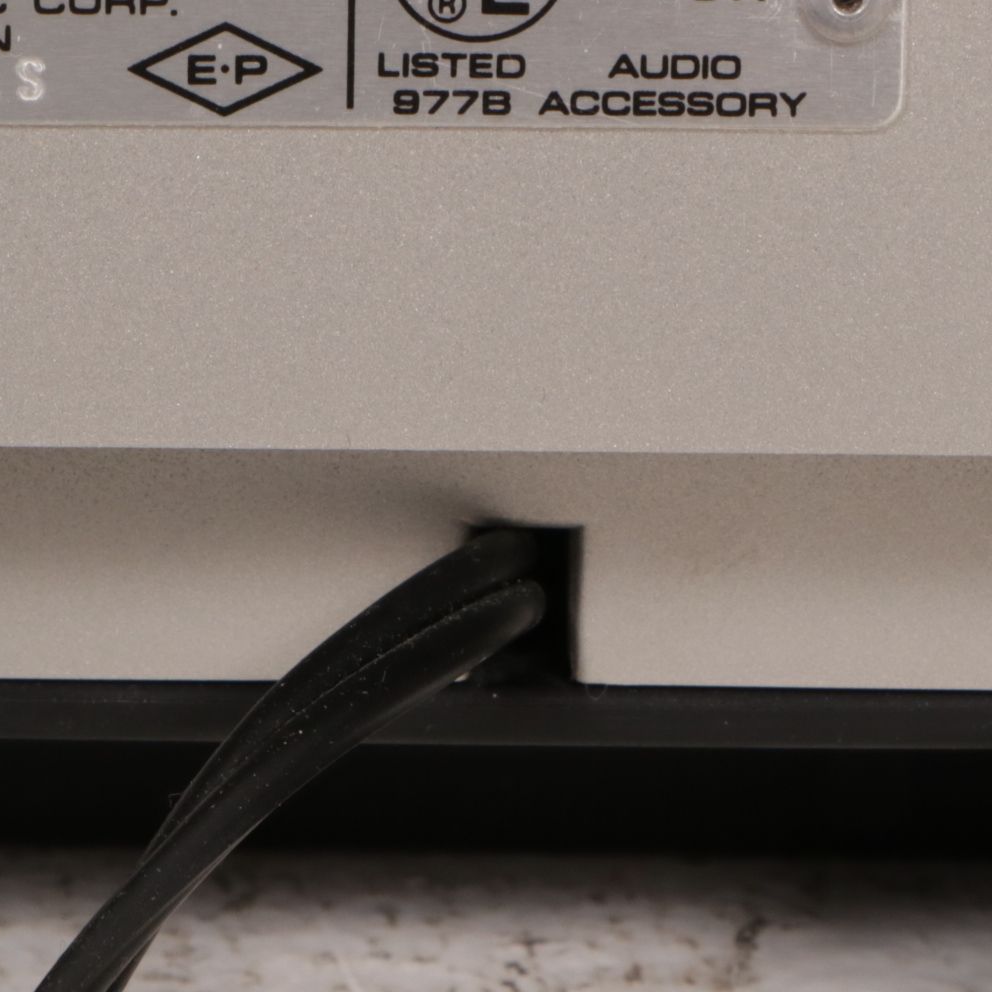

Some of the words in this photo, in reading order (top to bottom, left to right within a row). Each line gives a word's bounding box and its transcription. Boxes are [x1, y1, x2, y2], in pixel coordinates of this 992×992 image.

[378, 52, 526, 79] LISTED
[608, 54, 741, 80] AUDIO
[393, 89, 511, 115] 977B
[538, 90, 807, 117] ACCESSORY
